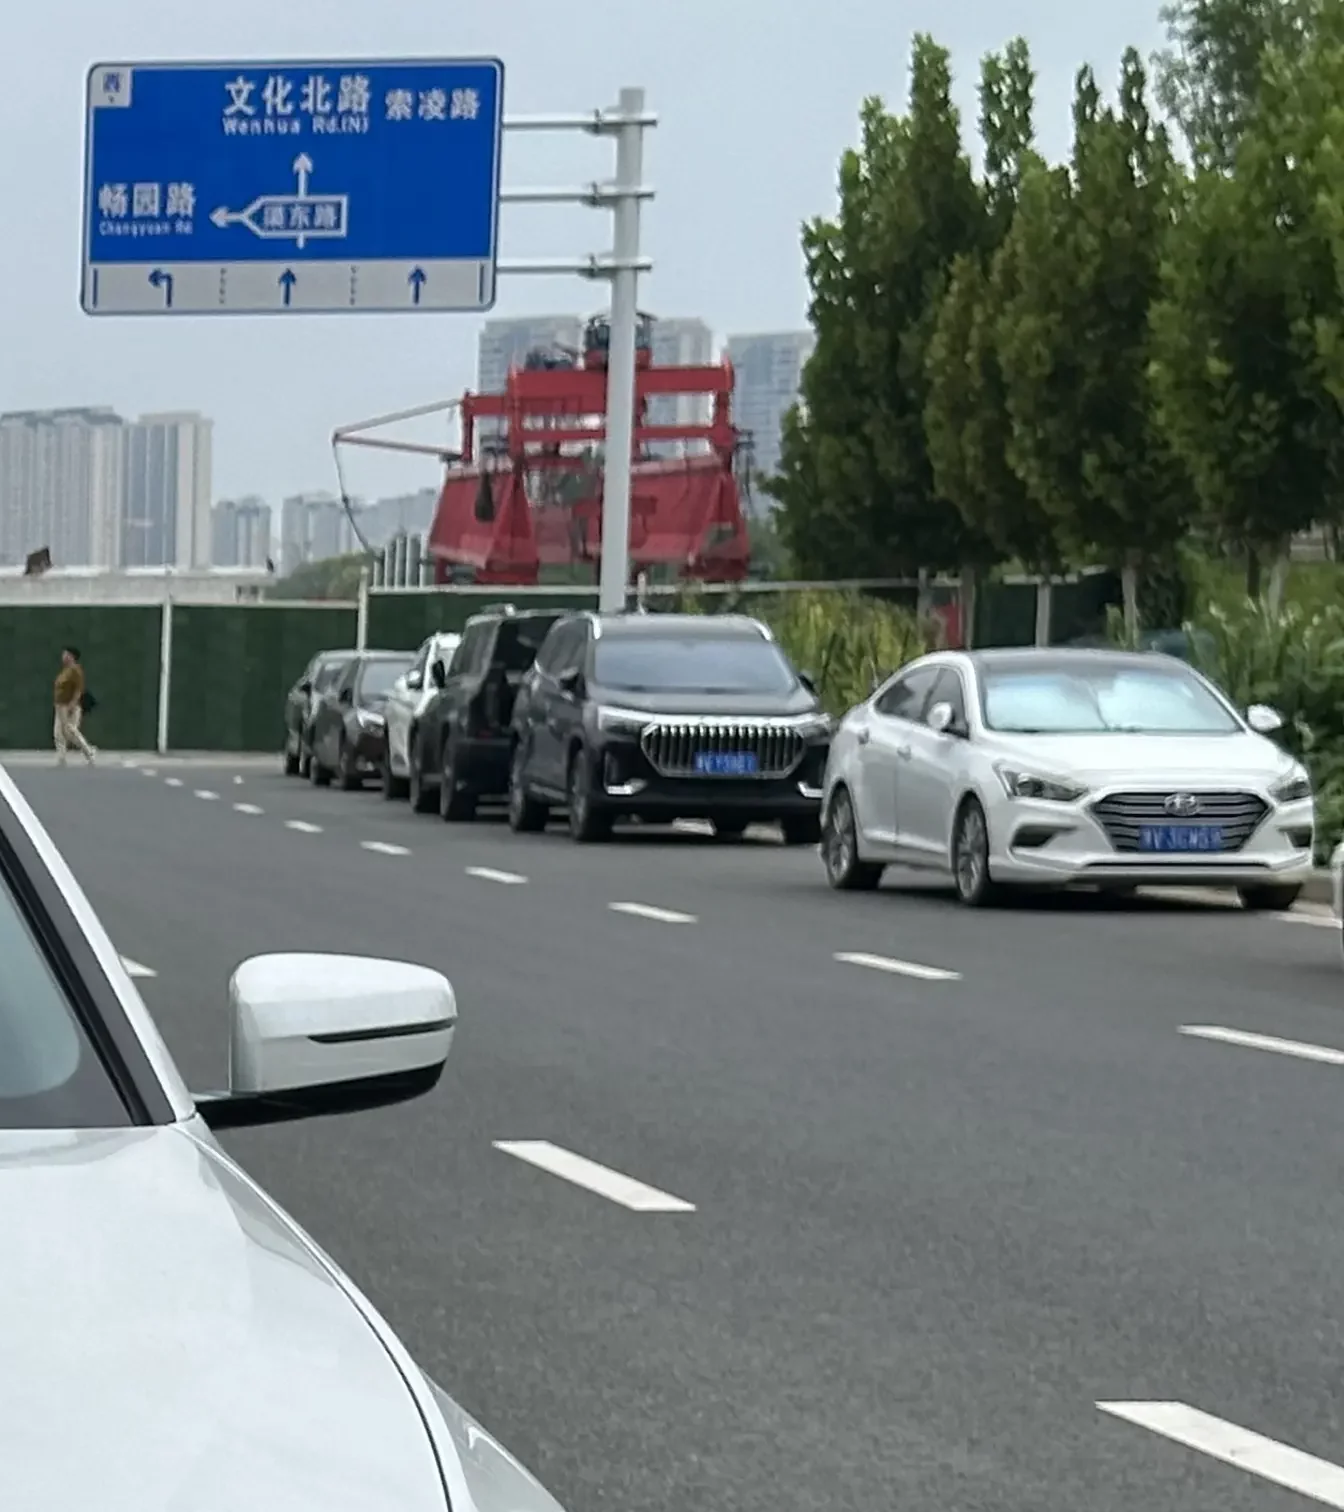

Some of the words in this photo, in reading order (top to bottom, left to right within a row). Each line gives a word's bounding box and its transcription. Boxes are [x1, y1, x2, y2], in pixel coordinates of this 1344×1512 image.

[223, 74, 371, 115] 文化北路
[385, 89, 480, 120] 索凌路
[223, 117, 301, 135] Wenhua
[99, 183, 196, 217] 畅园路
